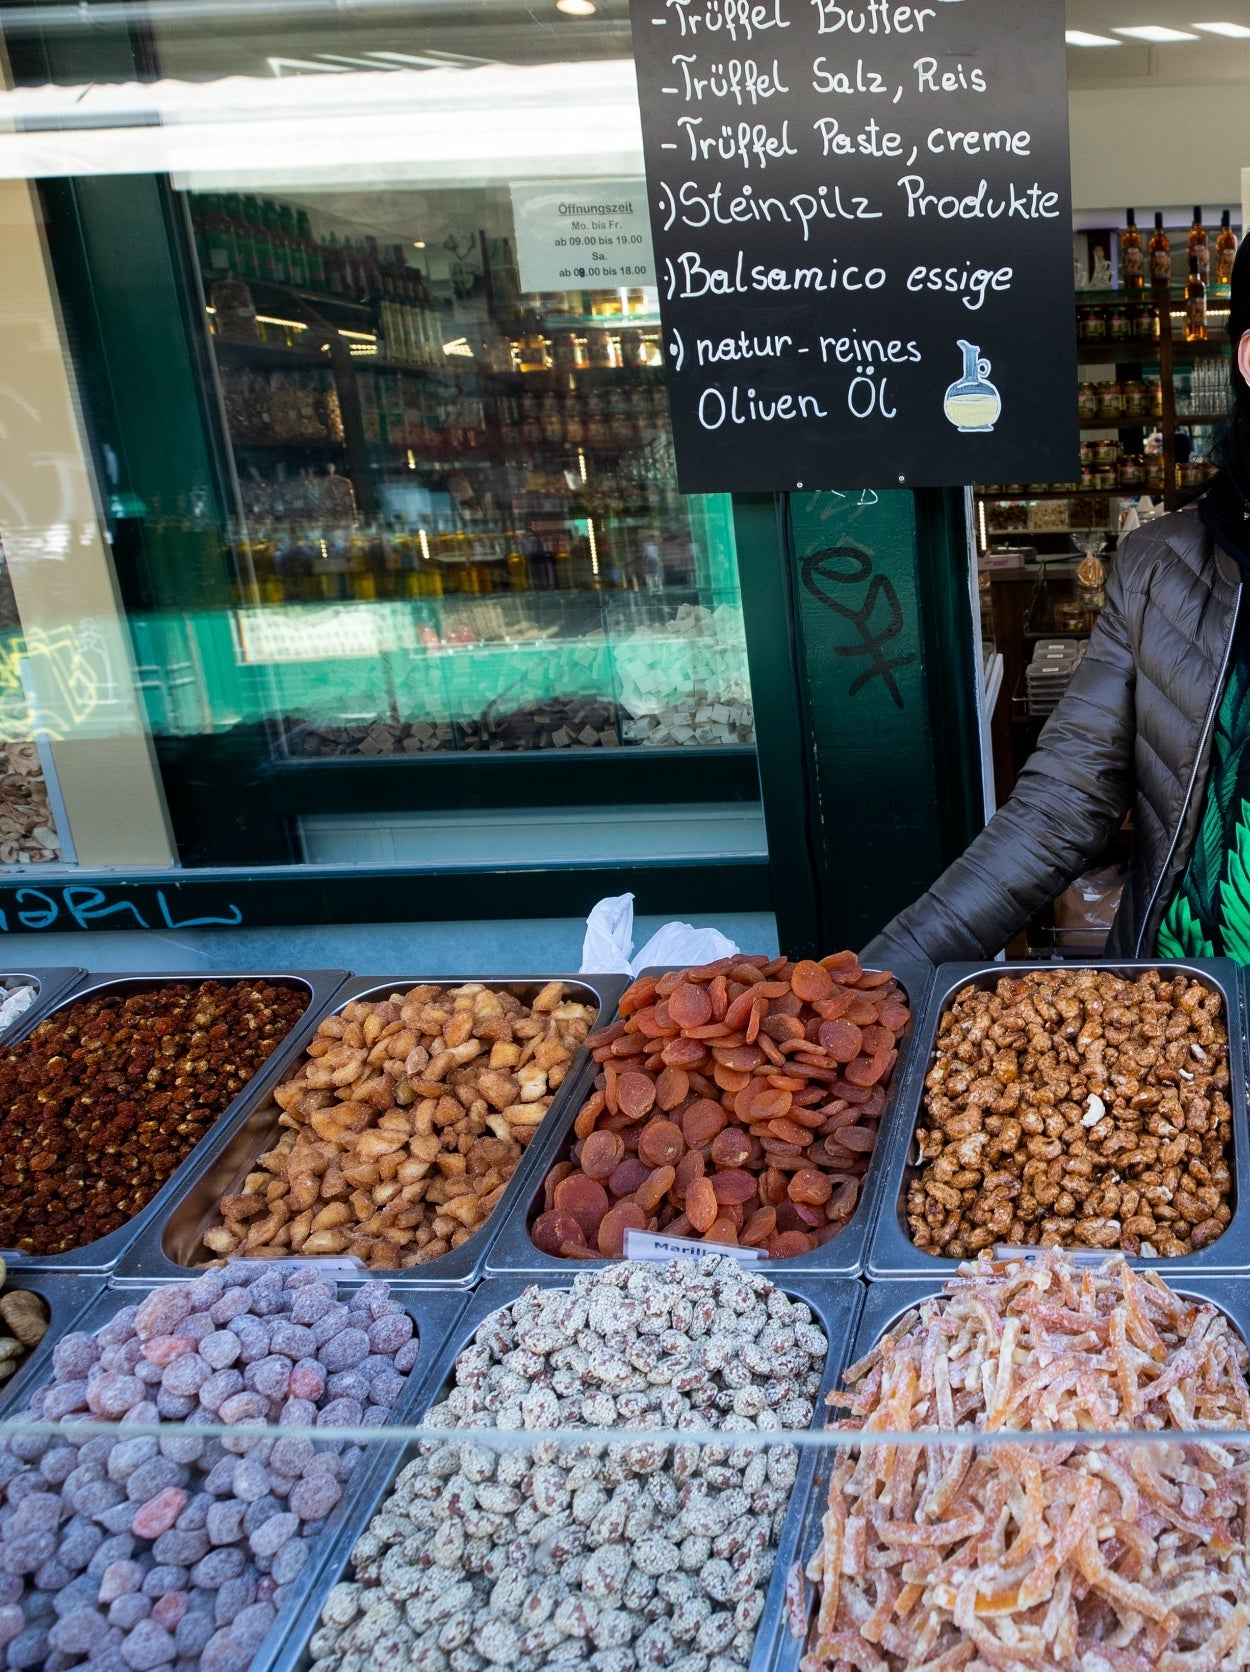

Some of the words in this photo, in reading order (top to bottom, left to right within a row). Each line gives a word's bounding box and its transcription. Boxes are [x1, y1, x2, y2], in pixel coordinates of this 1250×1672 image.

[811, 0, 937, 35] Butter
[913, 56, 988, 94] Reis
[927, 127, 1032, 156] creme
[558, 201, 634, 216] Öffnungszeit
[896, 174, 1060, 219] Produkte
[571, 221, 590, 230] Mo.
[592, 220, 607, 230] bis
[608, 220, 623, 229] Fr.
[554, 237, 567, 246] ab
[569, 236, 596, 246] 09.00
[598, 235, 614, 246] bis
[616, 234, 643, 245] 19.00
[559, 268, 571, 277] ab
[602, 266, 618, 276] bis
[619, 265, 647, 275] 18.00
[591, 252, 608, 261] Sa.
[906, 261, 1014, 311] essige
[698, 386, 828, 431] Oliven
[847, 365, 897, 419] Öl
